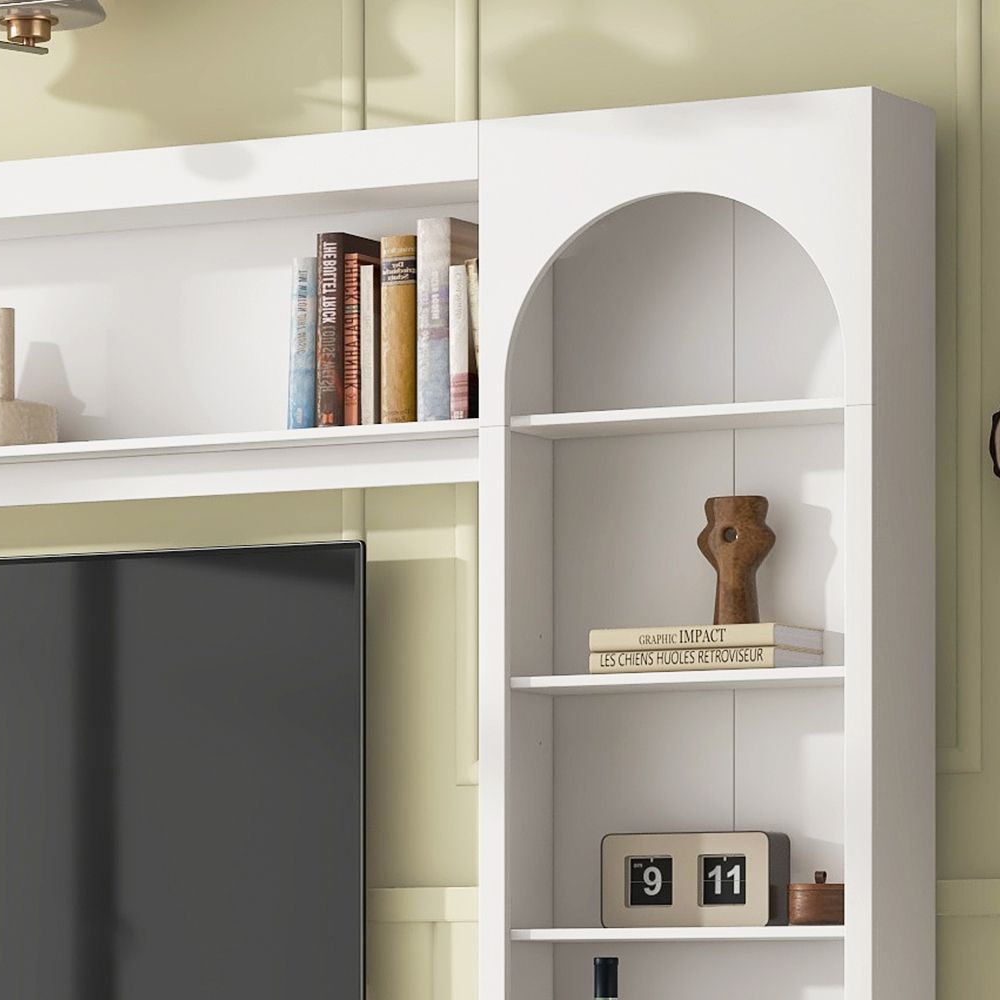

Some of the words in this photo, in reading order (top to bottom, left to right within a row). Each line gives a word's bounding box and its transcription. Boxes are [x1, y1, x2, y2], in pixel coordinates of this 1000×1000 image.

[638, 633, 678, 646] GRAPHIC
[679, 628, 727, 644] IMPACT
[600, 652, 616, 668] LES
[618, 650, 654, 667] CHIENS
[656, 649, 696, 666] HUOLES
[697, 648, 764, 664] RETROVISEUR
[643, 866, 662, 896] 9
[707, 864, 742, 895] 11
